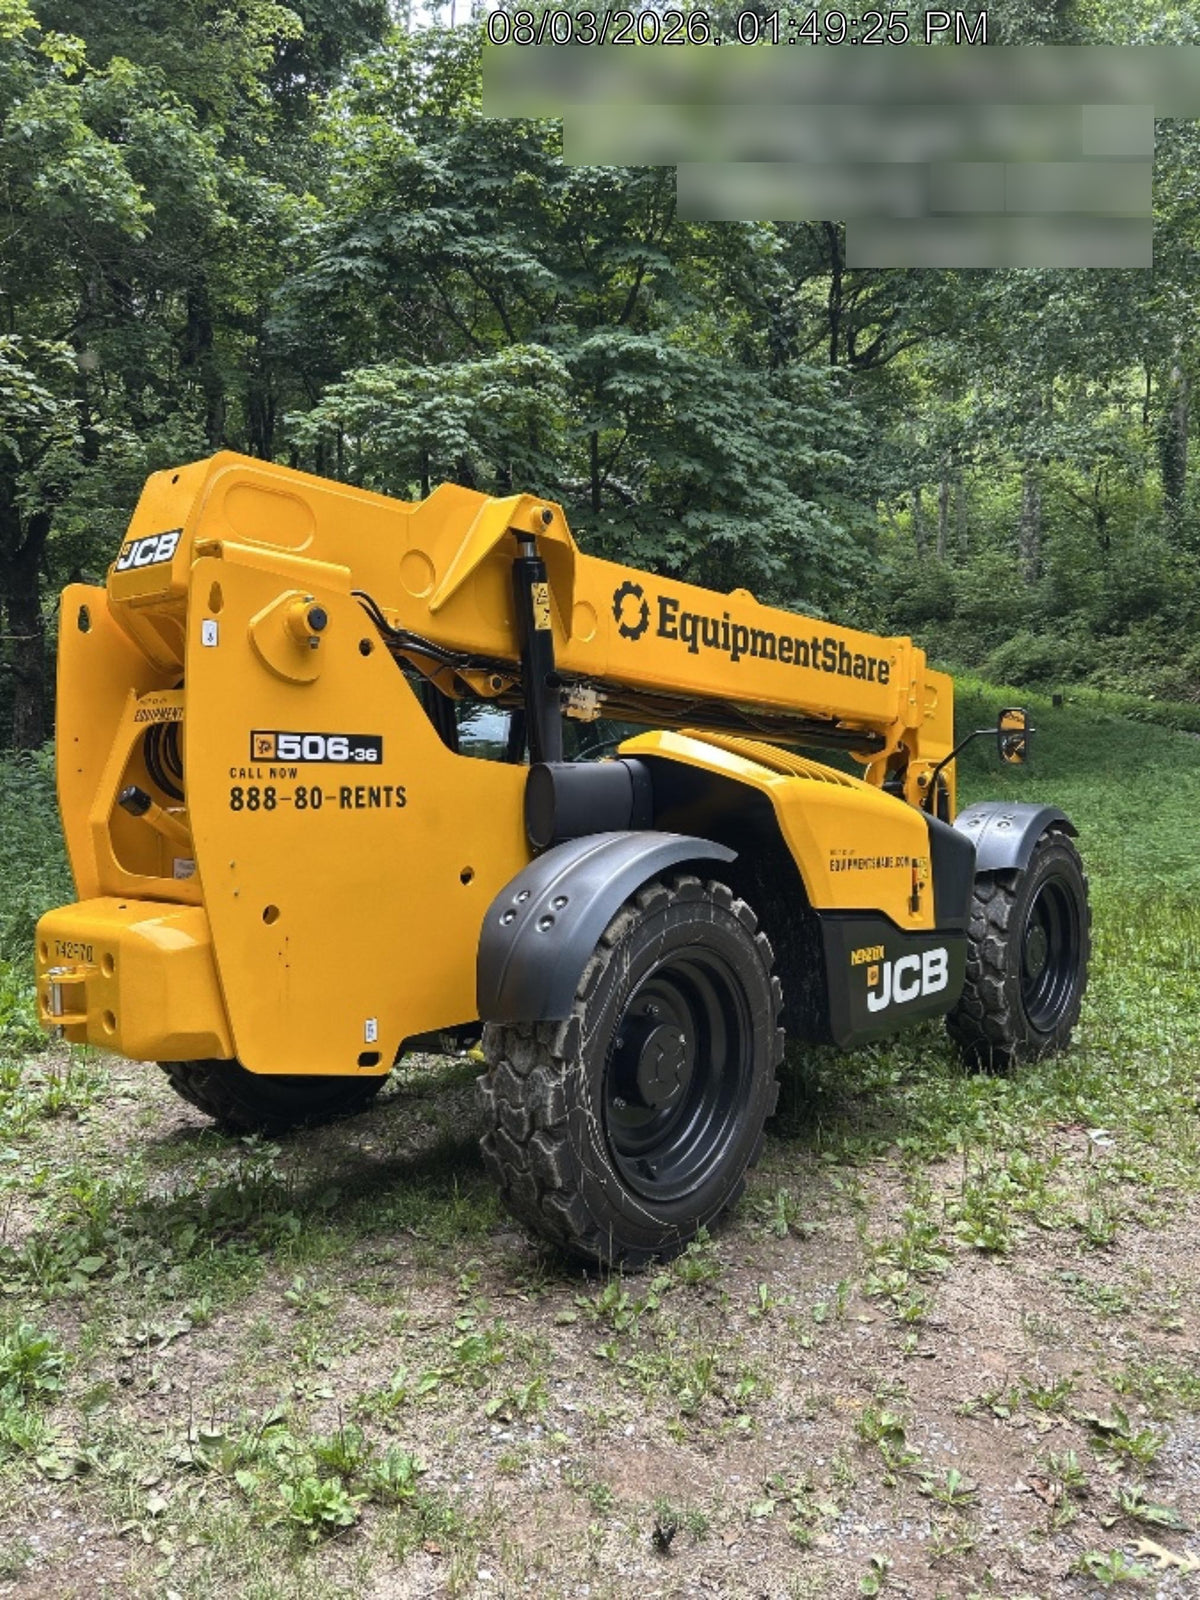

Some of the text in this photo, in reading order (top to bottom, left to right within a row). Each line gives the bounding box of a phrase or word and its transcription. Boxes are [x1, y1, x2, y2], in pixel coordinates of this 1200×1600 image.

[116, 531, 181, 571] JCB
[657, 595, 891, 686] EquipmentShare
[229, 767, 298, 779] CALL NOW
[229, 785, 408, 811] 888-80-RENTS
[866, 946, 949, 1013] JCB
